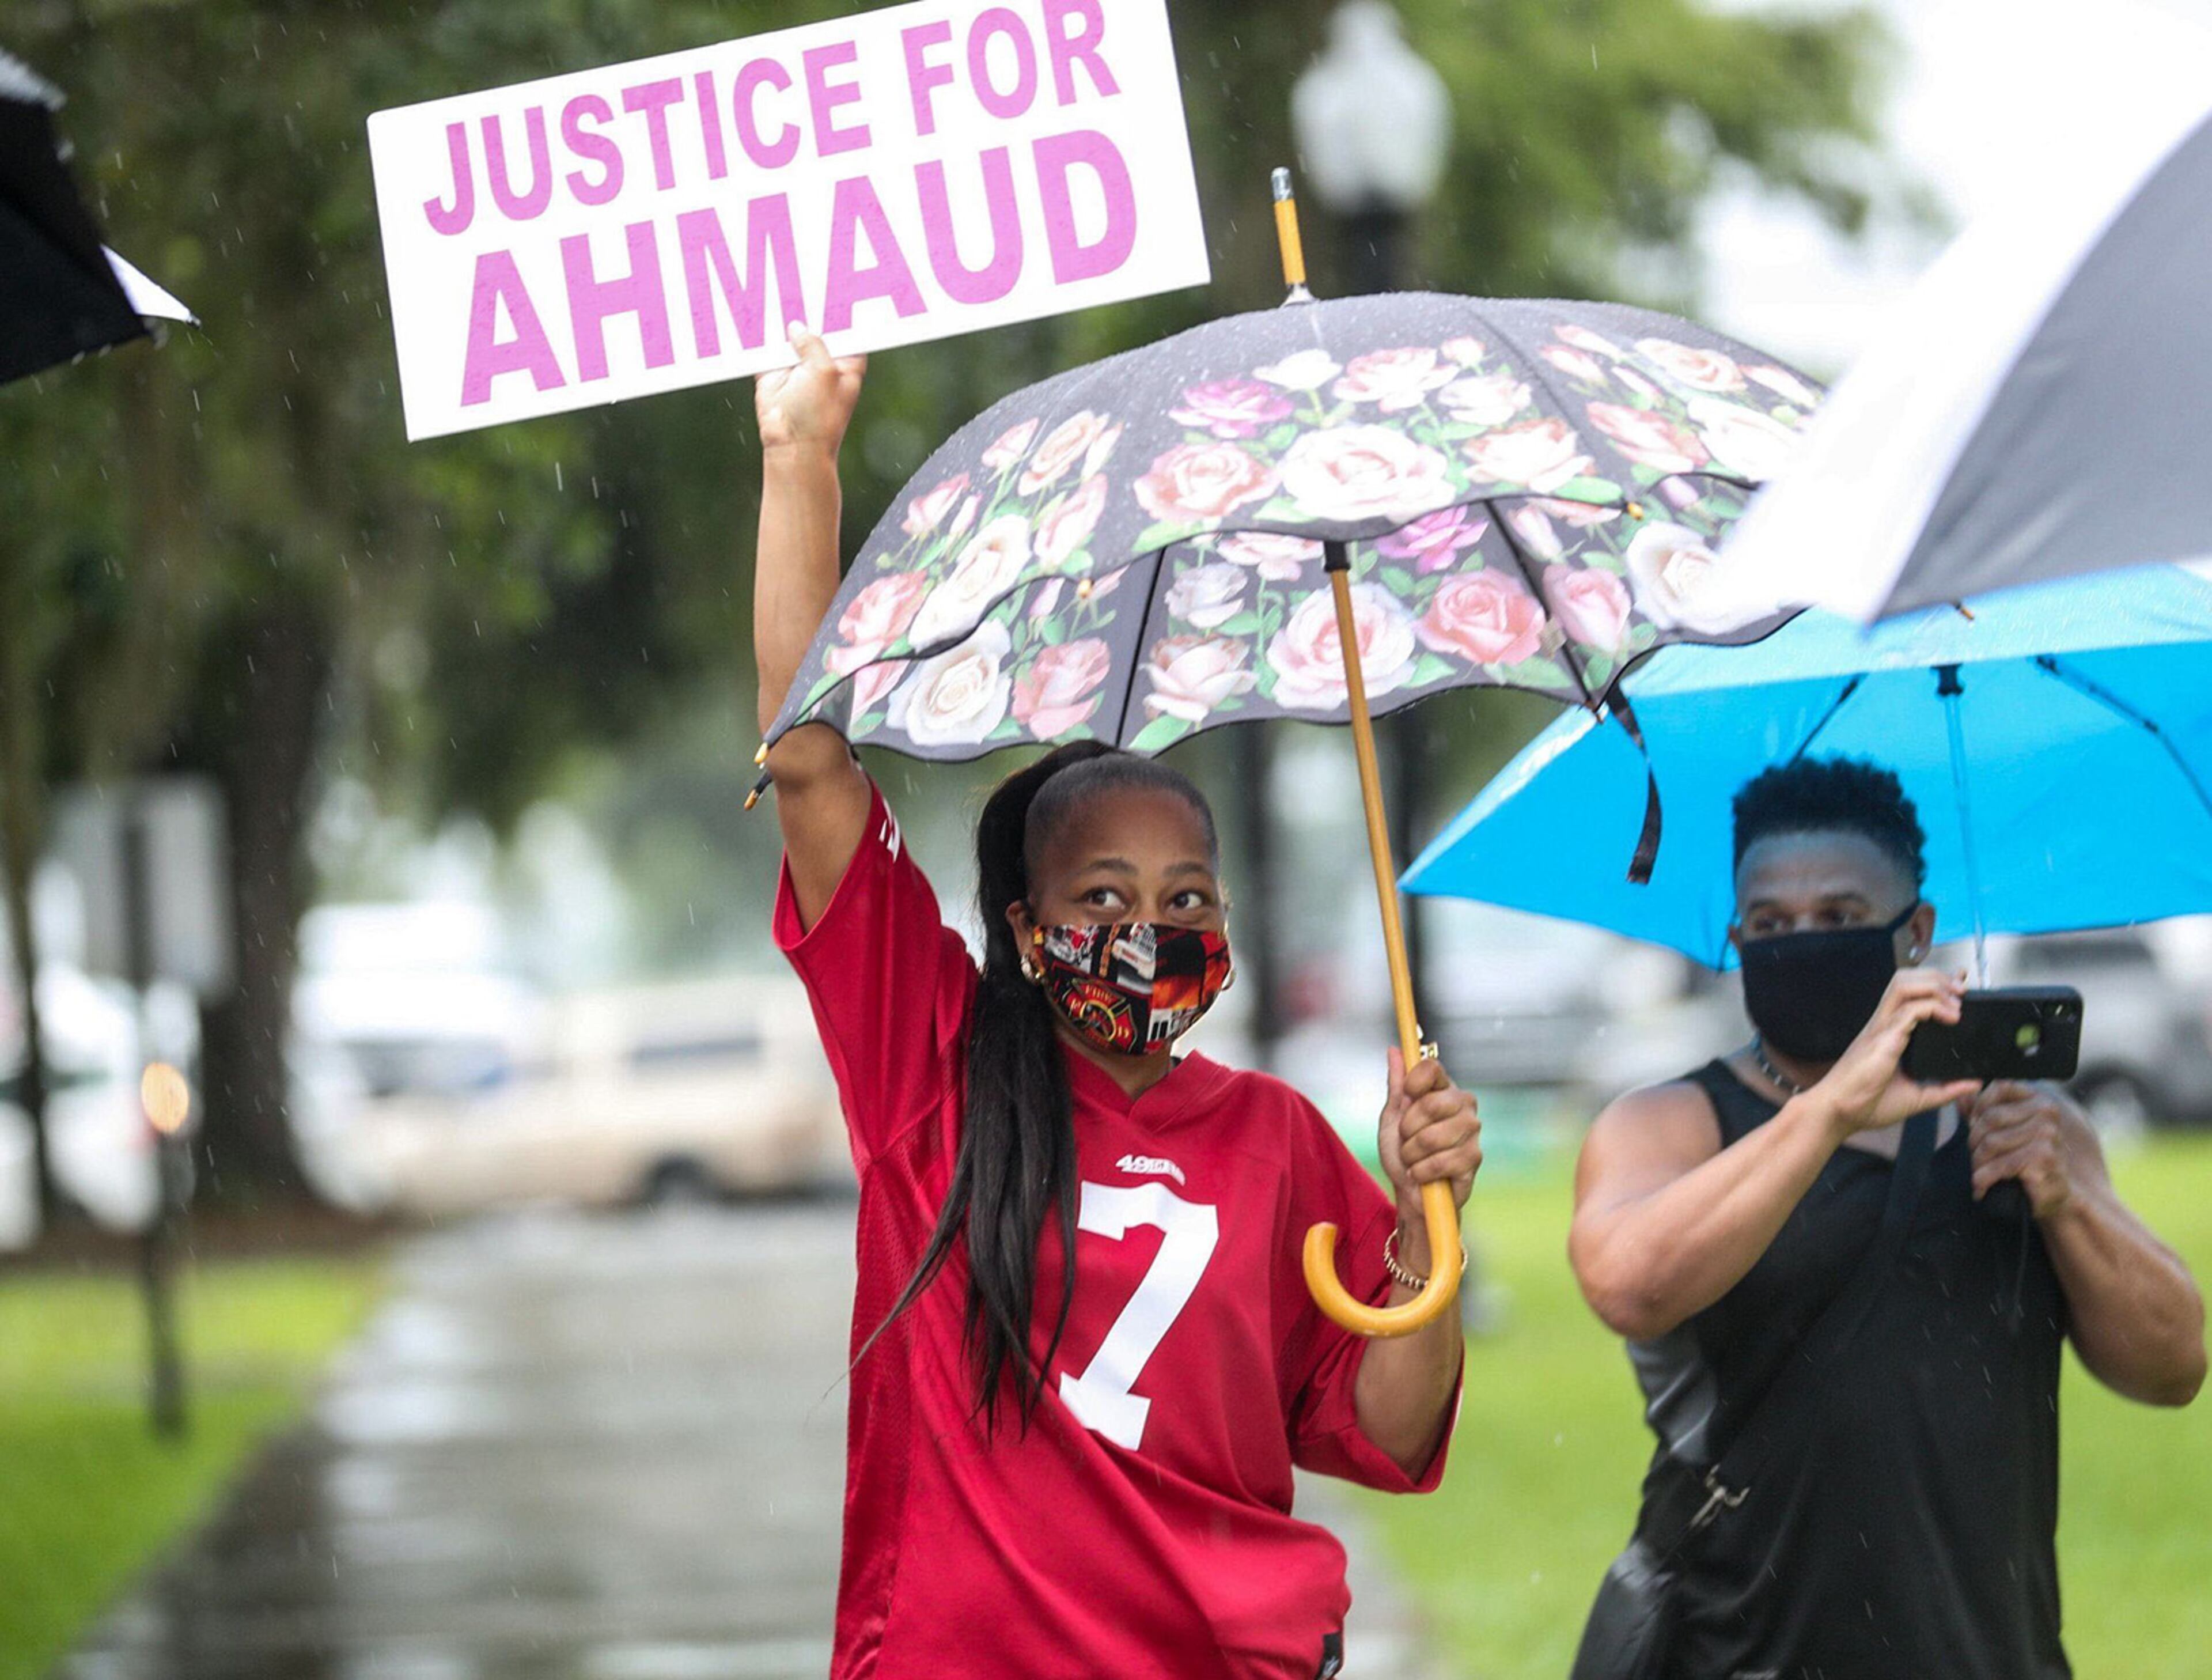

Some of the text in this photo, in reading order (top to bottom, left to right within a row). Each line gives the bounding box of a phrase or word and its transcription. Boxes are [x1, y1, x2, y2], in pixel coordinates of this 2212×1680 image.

[423, 0, 1120, 236] JUSTICE FOR
[460, 129, 1136, 407] AHMAUD
[1059, 1181, 1219, 1451] 7
